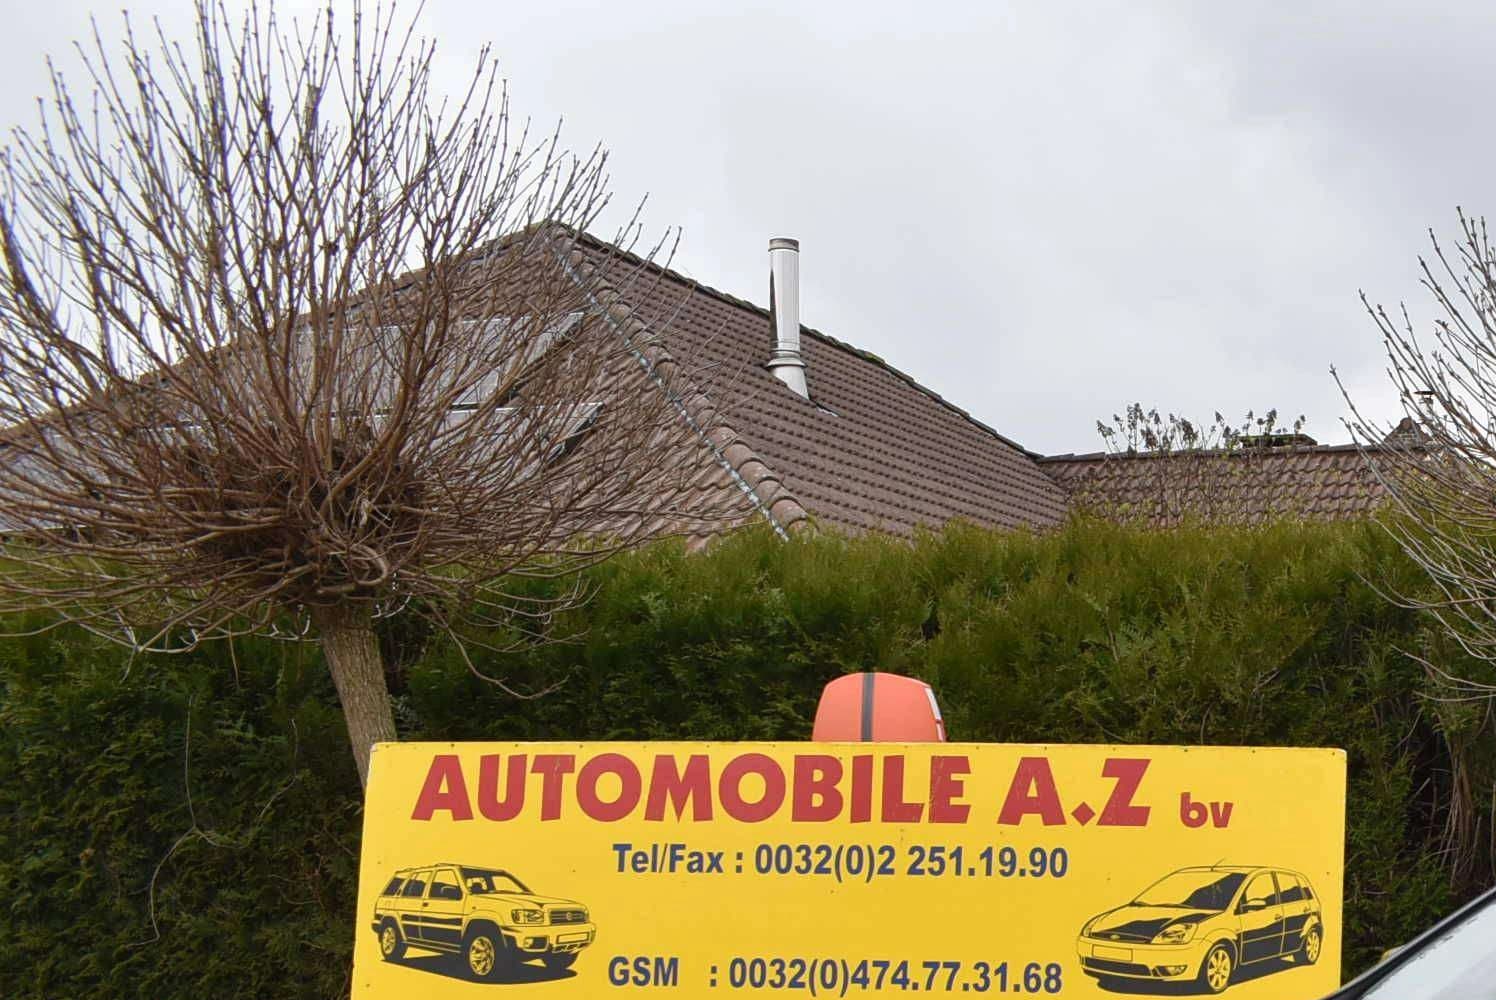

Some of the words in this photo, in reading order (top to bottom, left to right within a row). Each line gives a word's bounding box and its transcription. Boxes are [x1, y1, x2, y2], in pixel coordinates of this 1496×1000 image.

[411, 752, 971, 824] AUTOMOBILE
[1180, 791, 1234, 829] bv
[612, 843, 724, 876] Tel/Fax
[755, 844, 896, 884] 0032(0)2
[906, 845, 1068, 878] 251.19.90
[608, 956, 679, 987] GSM
[729, 957, 1062, 998] 0032(0)474.77.31.68
